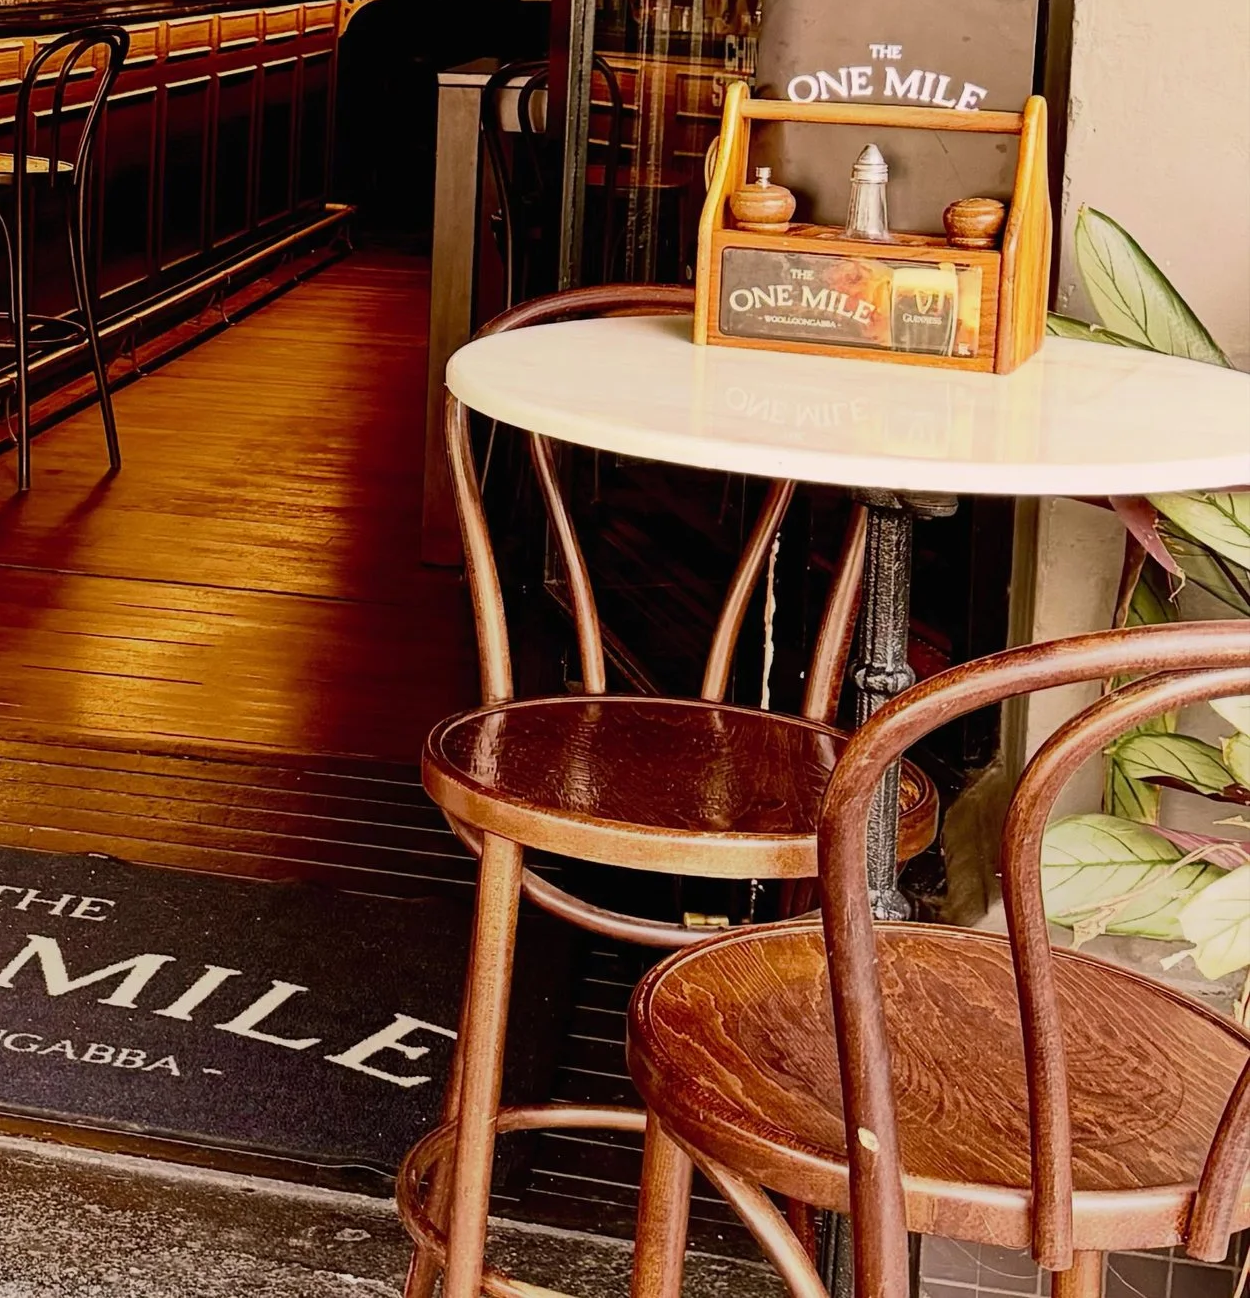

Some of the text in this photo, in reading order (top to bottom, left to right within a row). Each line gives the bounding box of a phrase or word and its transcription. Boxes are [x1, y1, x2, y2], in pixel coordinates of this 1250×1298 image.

[869, 43, 902, 60] THE
[787, 66, 874, 103] ONE
[883, 68, 989, 113] MILE
[790, 268, 814, 281] THE
[729, 284, 876, 325] ONE MILE
